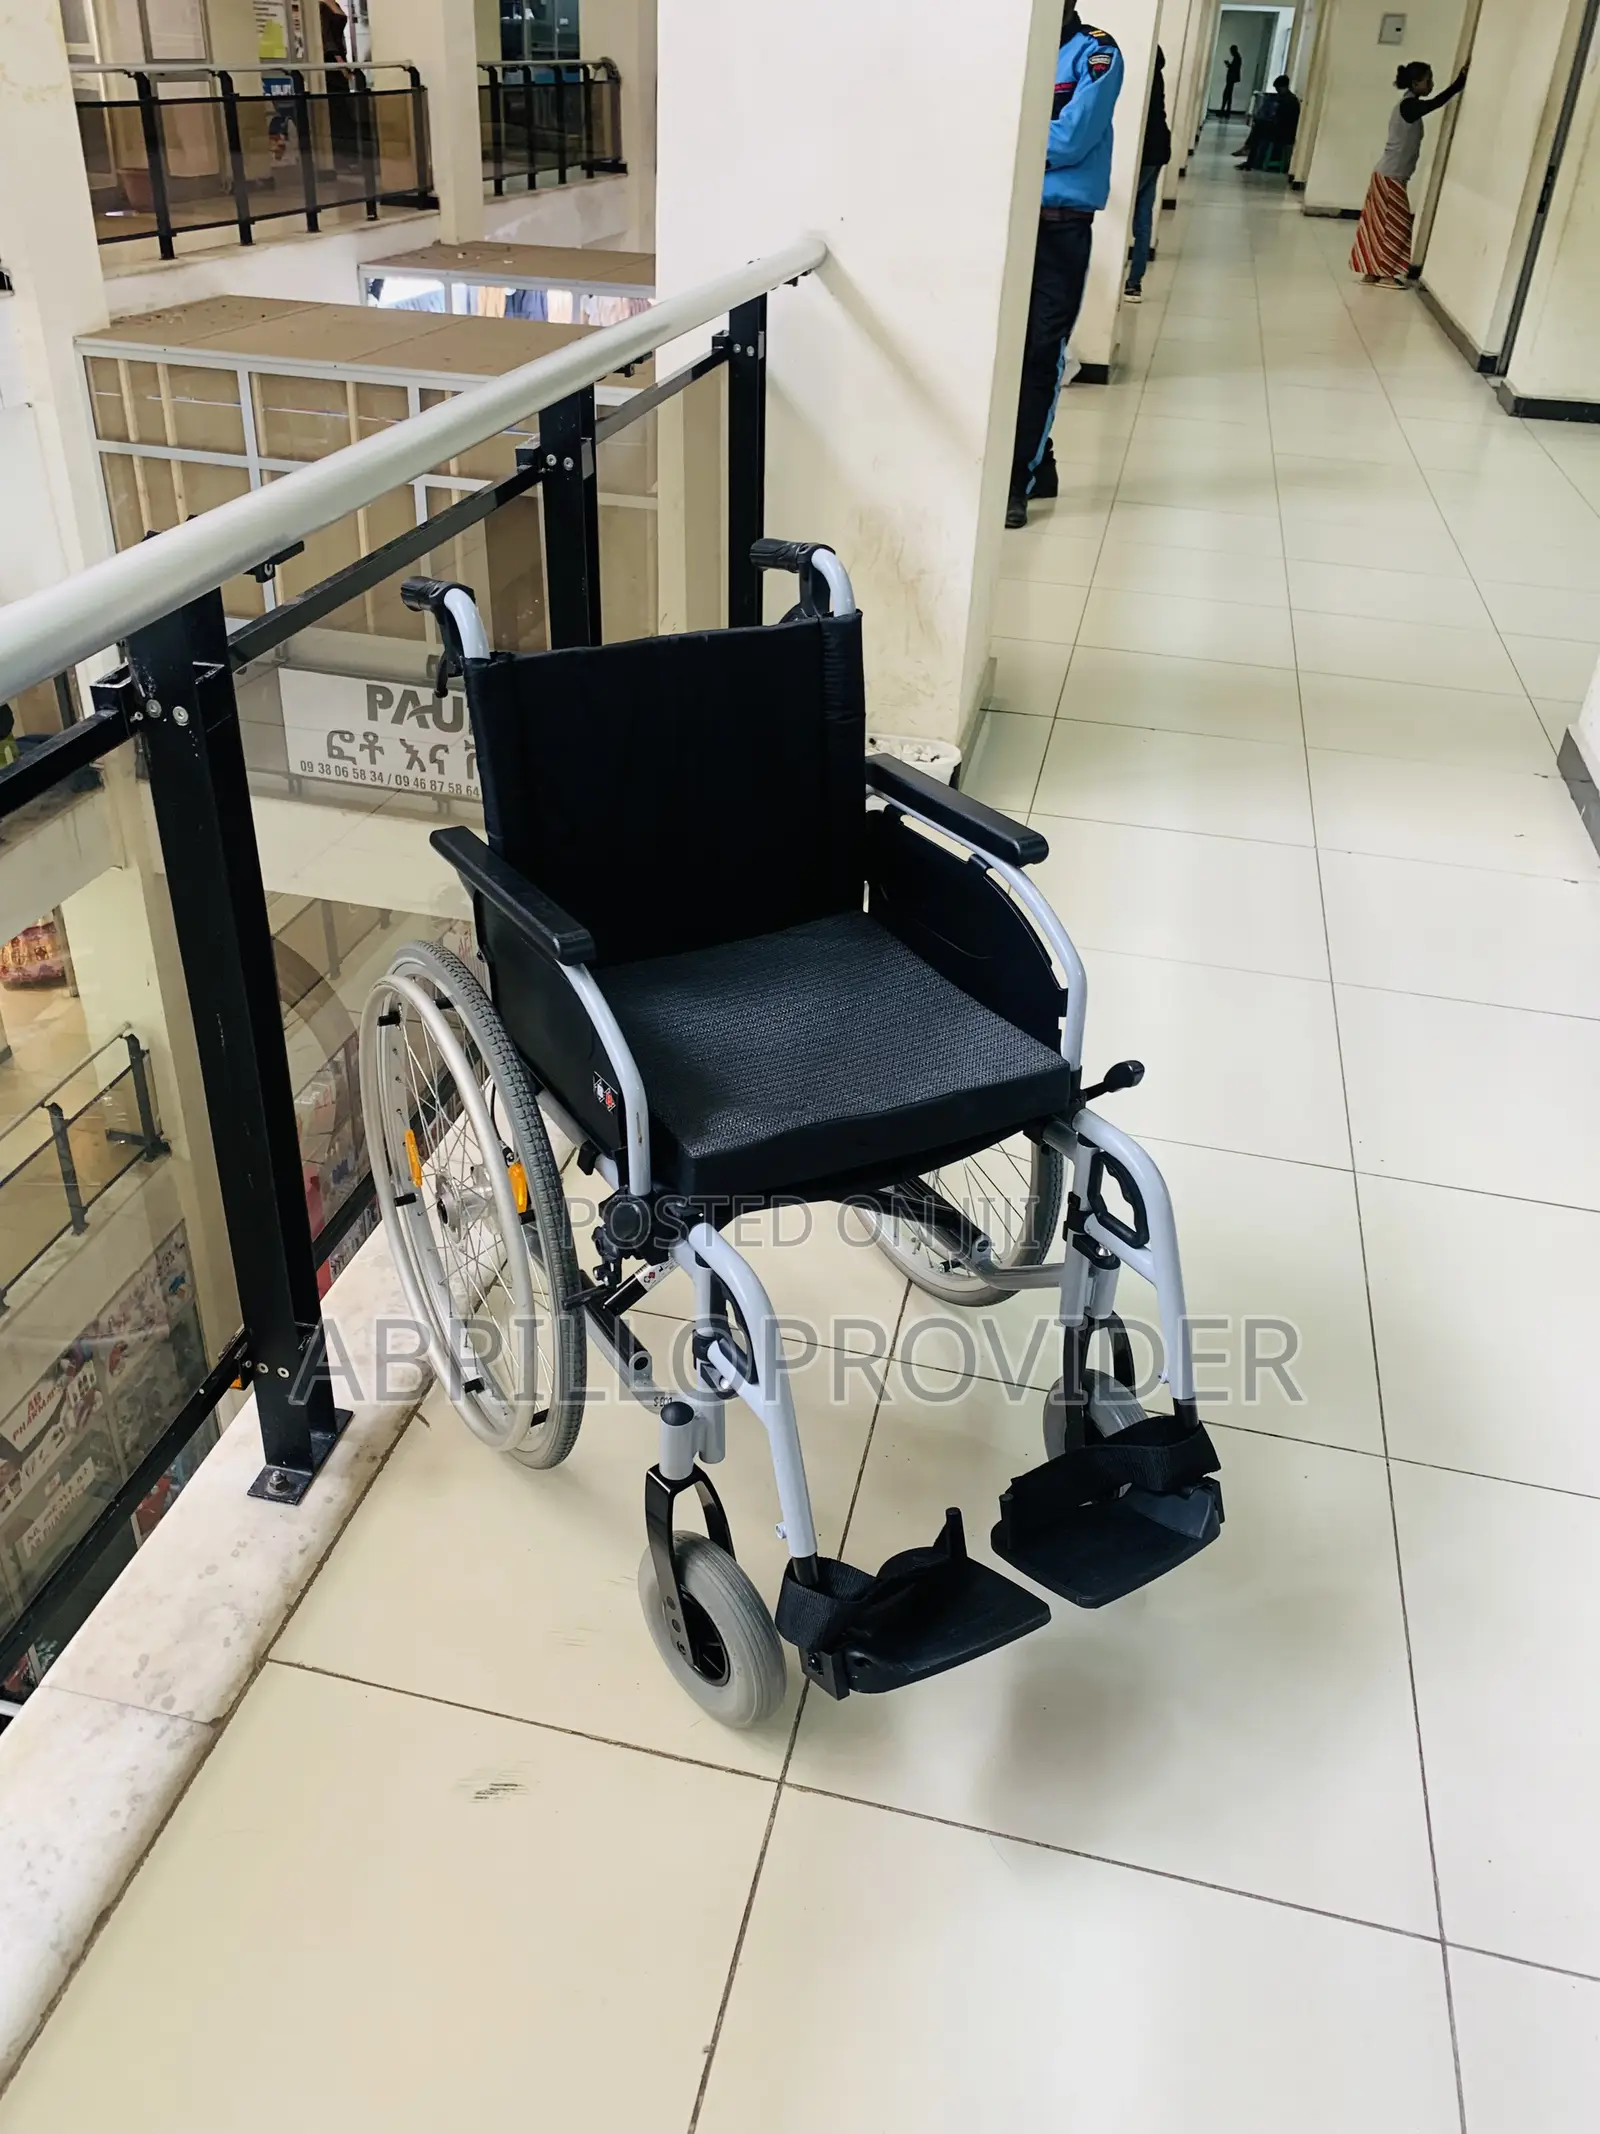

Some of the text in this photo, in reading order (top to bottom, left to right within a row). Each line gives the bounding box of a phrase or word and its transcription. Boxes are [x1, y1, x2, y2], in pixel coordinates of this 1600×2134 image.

[366, 684, 474, 735] PAU
[300, 760, 314, 773] 09
[318, 762, 332, 776] 38
[334, 765, 349, 778] 06
[352, 768, 367, 781] 58
[369, 770, 384, 783] 34
[395, 774, 410, 787] 09
[413, 777, 426, 790] 46
[429, 780, 444, 792] 87
[448, 783, 462, 795] 58
[465, 785, 480, 798] 64
